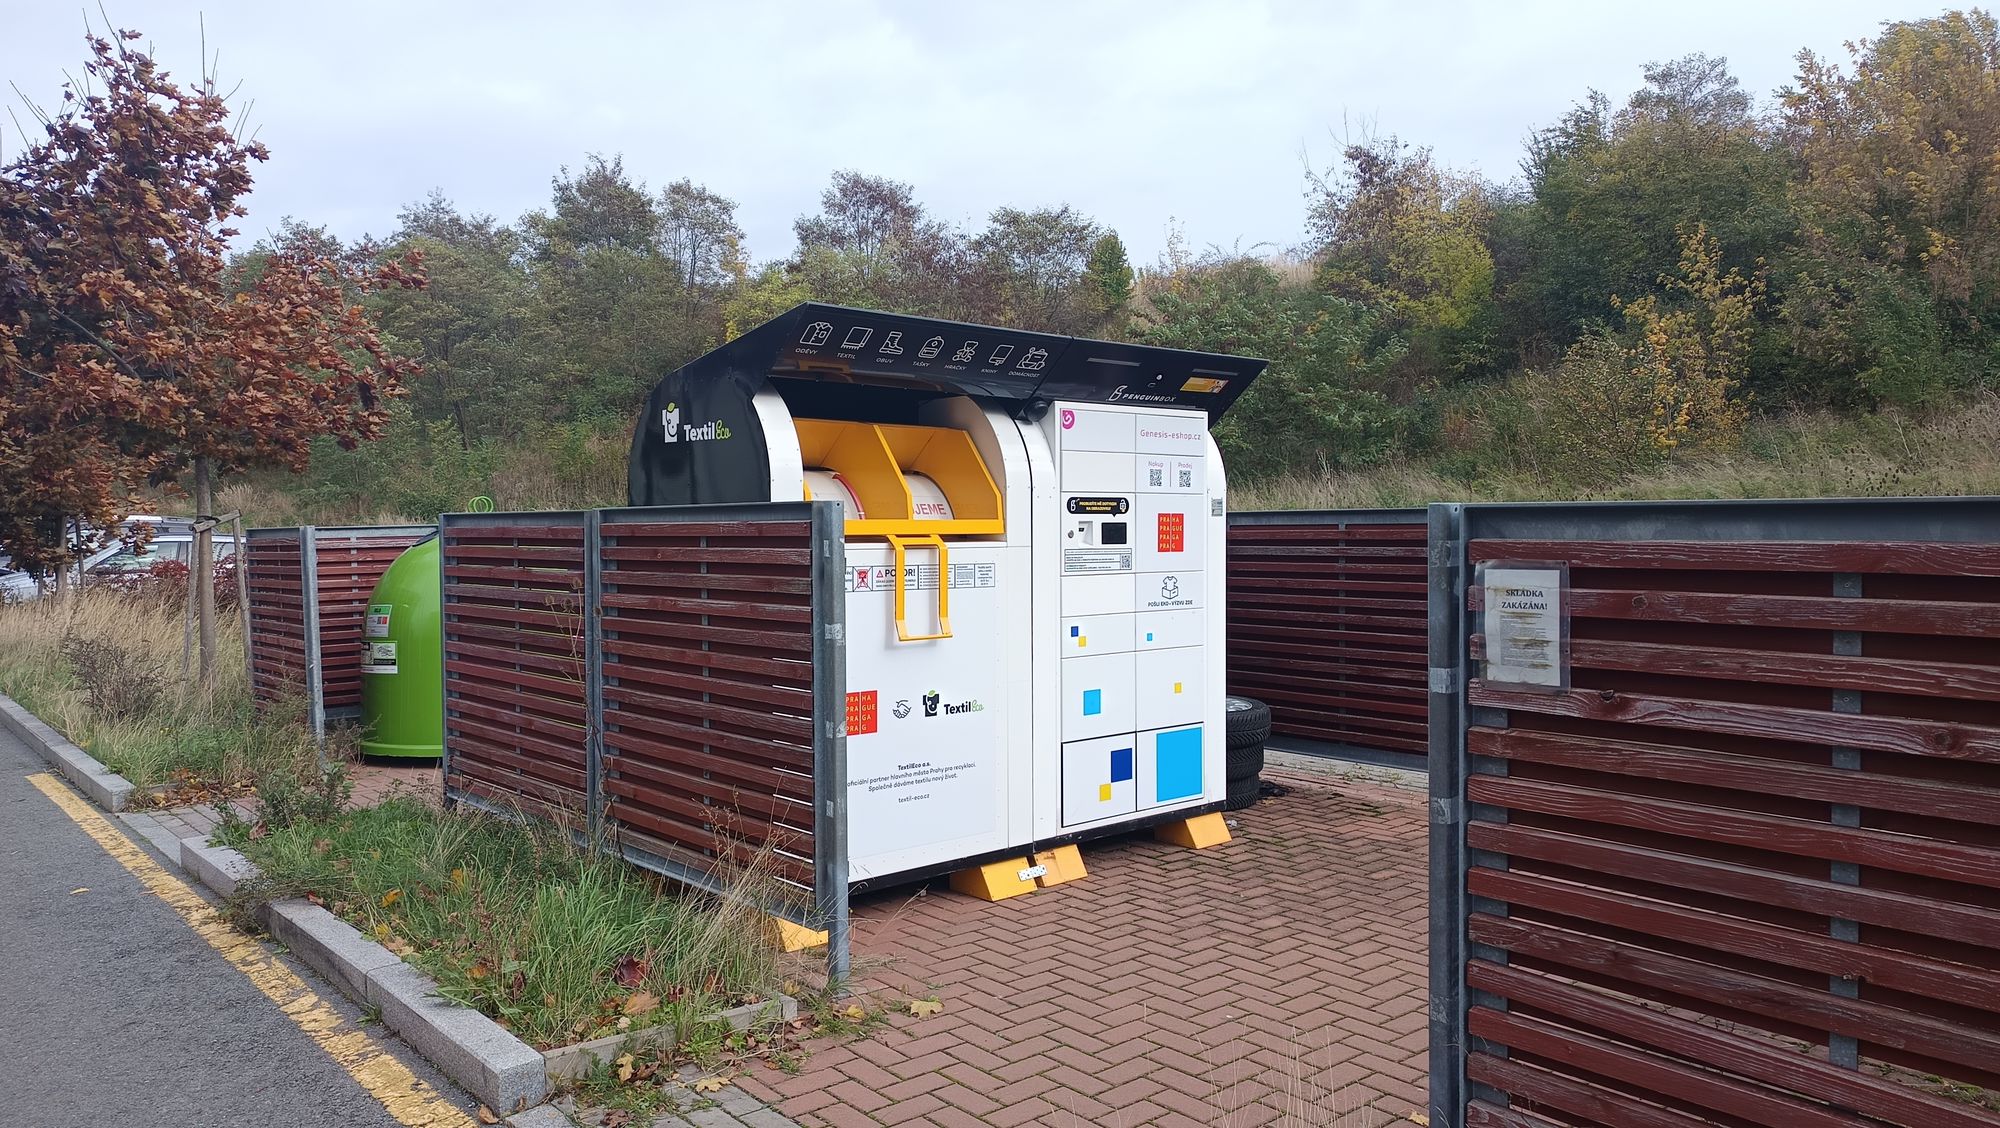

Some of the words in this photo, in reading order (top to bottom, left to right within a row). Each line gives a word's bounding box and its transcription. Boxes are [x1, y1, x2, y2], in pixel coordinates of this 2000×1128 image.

[1122, 393, 1176, 402] PENGUINBOX
[1140, 429, 1201, 441] Genesis-eshop.cz
[912, 503, 947, 516] JEME
[1501, 600, 1548, 610] ZAKÁZÁNA!
[861, 703, 876, 711] GUE
[861, 713, 872, 721] GA
[898, 762, 922, 771] TextilEco
[869, 775, 890, 784] partner
[890, 771, 912, 780] hlavního
[913, 769, 929, 777] města
[868, 782, 893, 792] Společně
[893, 778, 914, 788] dáváme
[914, 776, 931, 785] textilu
[898, 793, 930, 803] textil-eco.cz
